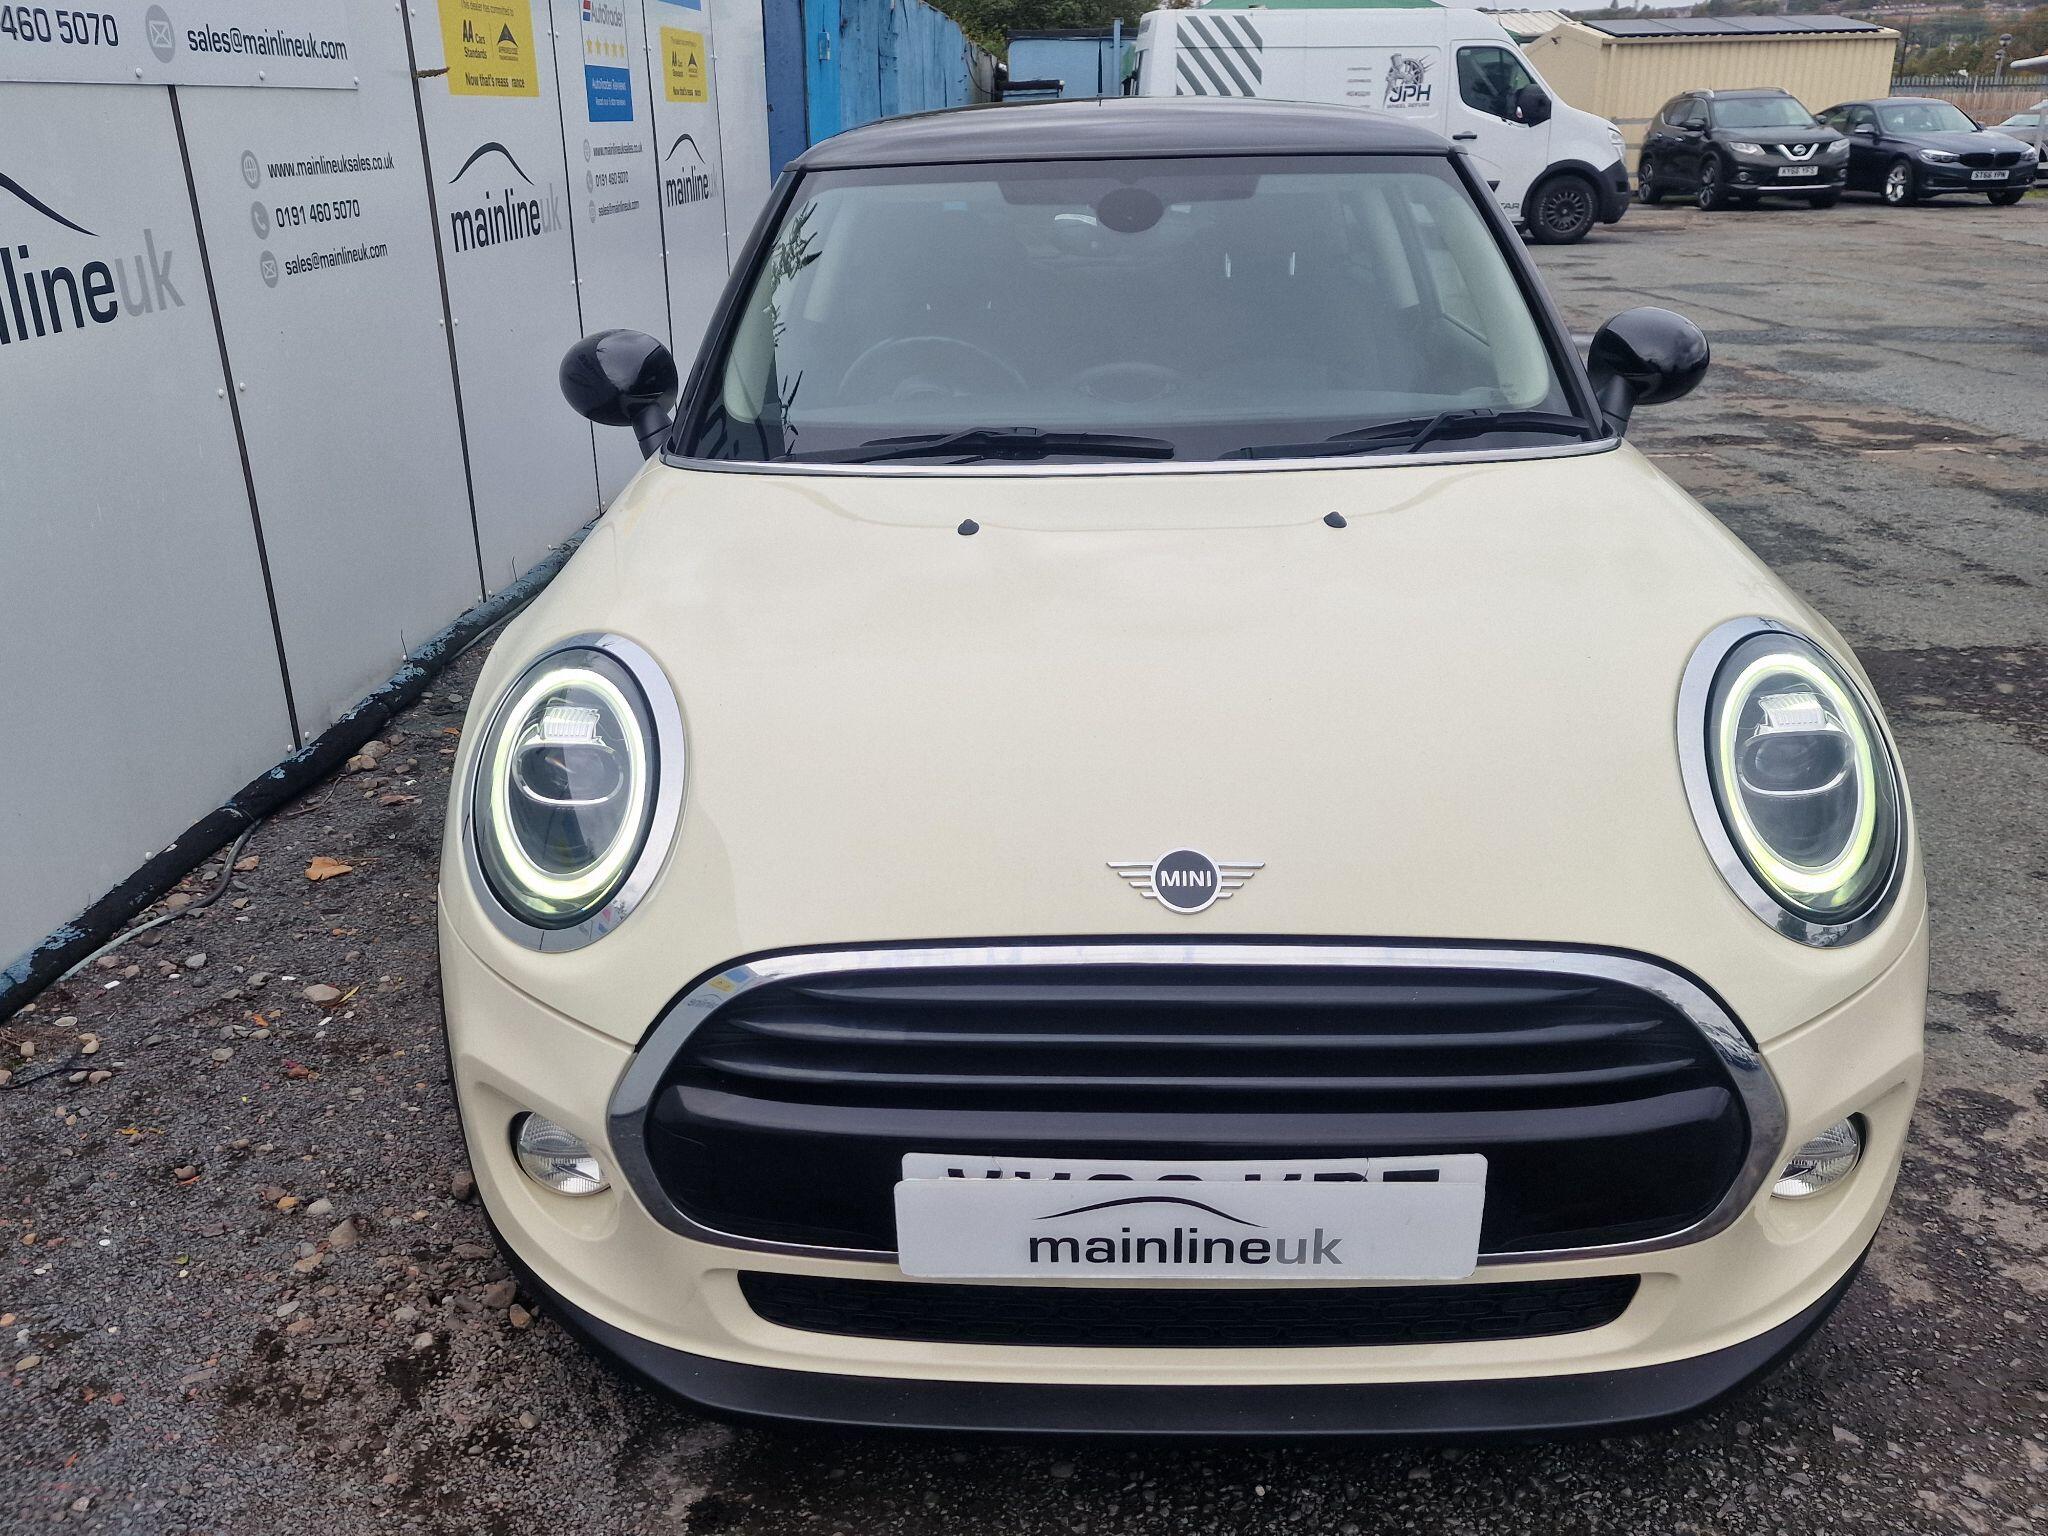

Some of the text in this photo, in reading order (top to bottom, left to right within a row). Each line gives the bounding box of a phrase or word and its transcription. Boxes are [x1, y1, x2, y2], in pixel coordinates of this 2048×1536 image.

[1, 5, 119, 47] 460 5070
[187, 23, 348, 60] sales@mainlineuk.com
[463, 19, 486, 44] AA Cars
[465, 72, 479, 87] Now
[479, 73, 495, 87] that's
[1389, 84, 1431, 103] JPH
[267, 152, 395, 179] www.mainlineuksales.co.uk
[275, 199, 360, 228] 0191 460 5070
[450, 183, 562, 253] mainlineuk
[285, 242, 389, 276] sales@mainlineuk.com
[0, 229, 186, 345] lineuk
[1160, 870, 1212, 888] MINI
[1029, 1227, 1344, 1265] mainlineuk
